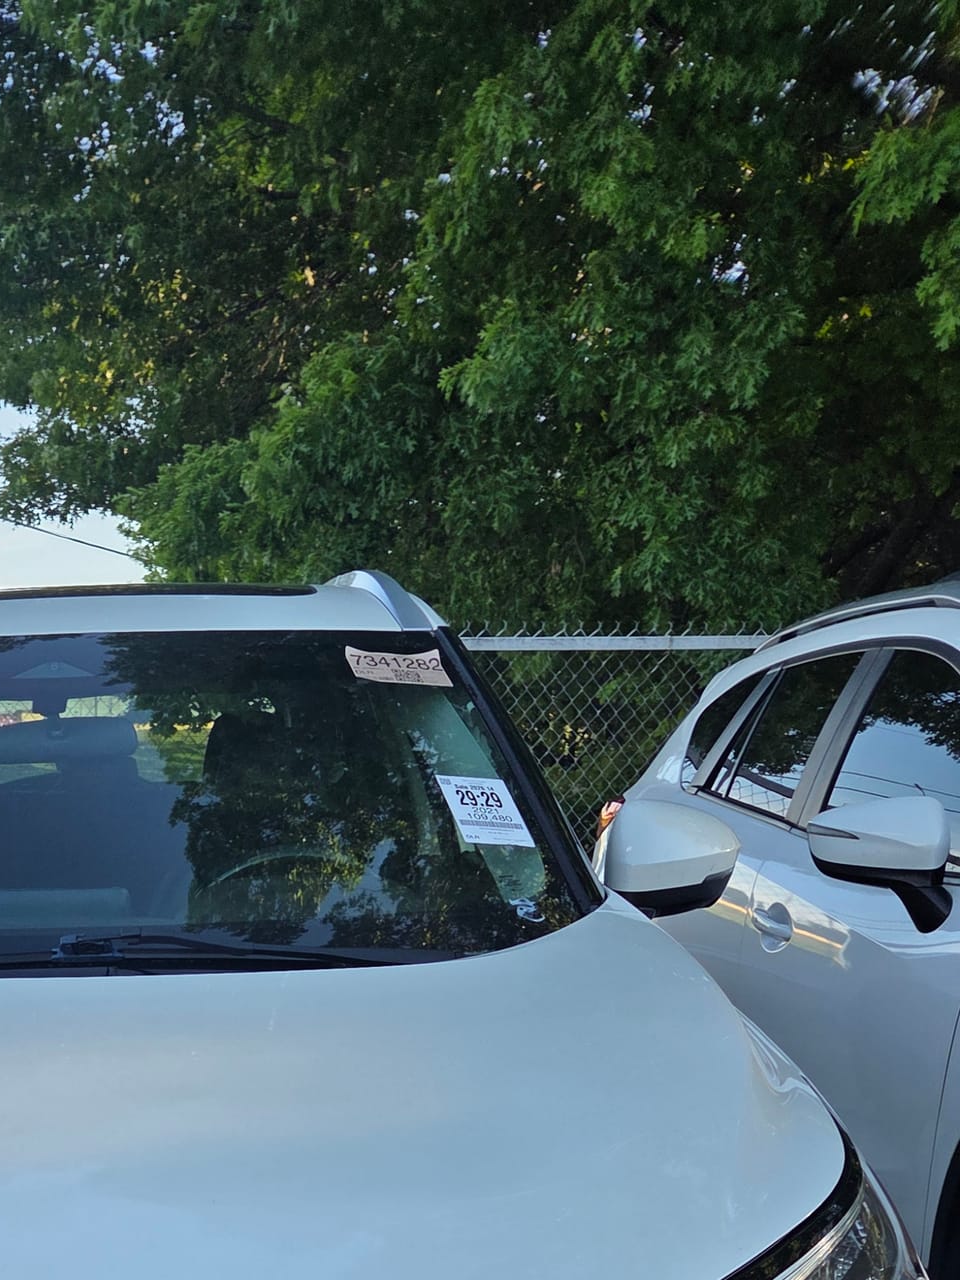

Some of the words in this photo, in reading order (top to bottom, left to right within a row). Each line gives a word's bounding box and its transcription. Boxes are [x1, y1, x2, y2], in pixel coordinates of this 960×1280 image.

[350, 654, 444, 672] 7341282
[455, 789, 503, 808] 29:29
[472, 806, 500, 815] 2021
